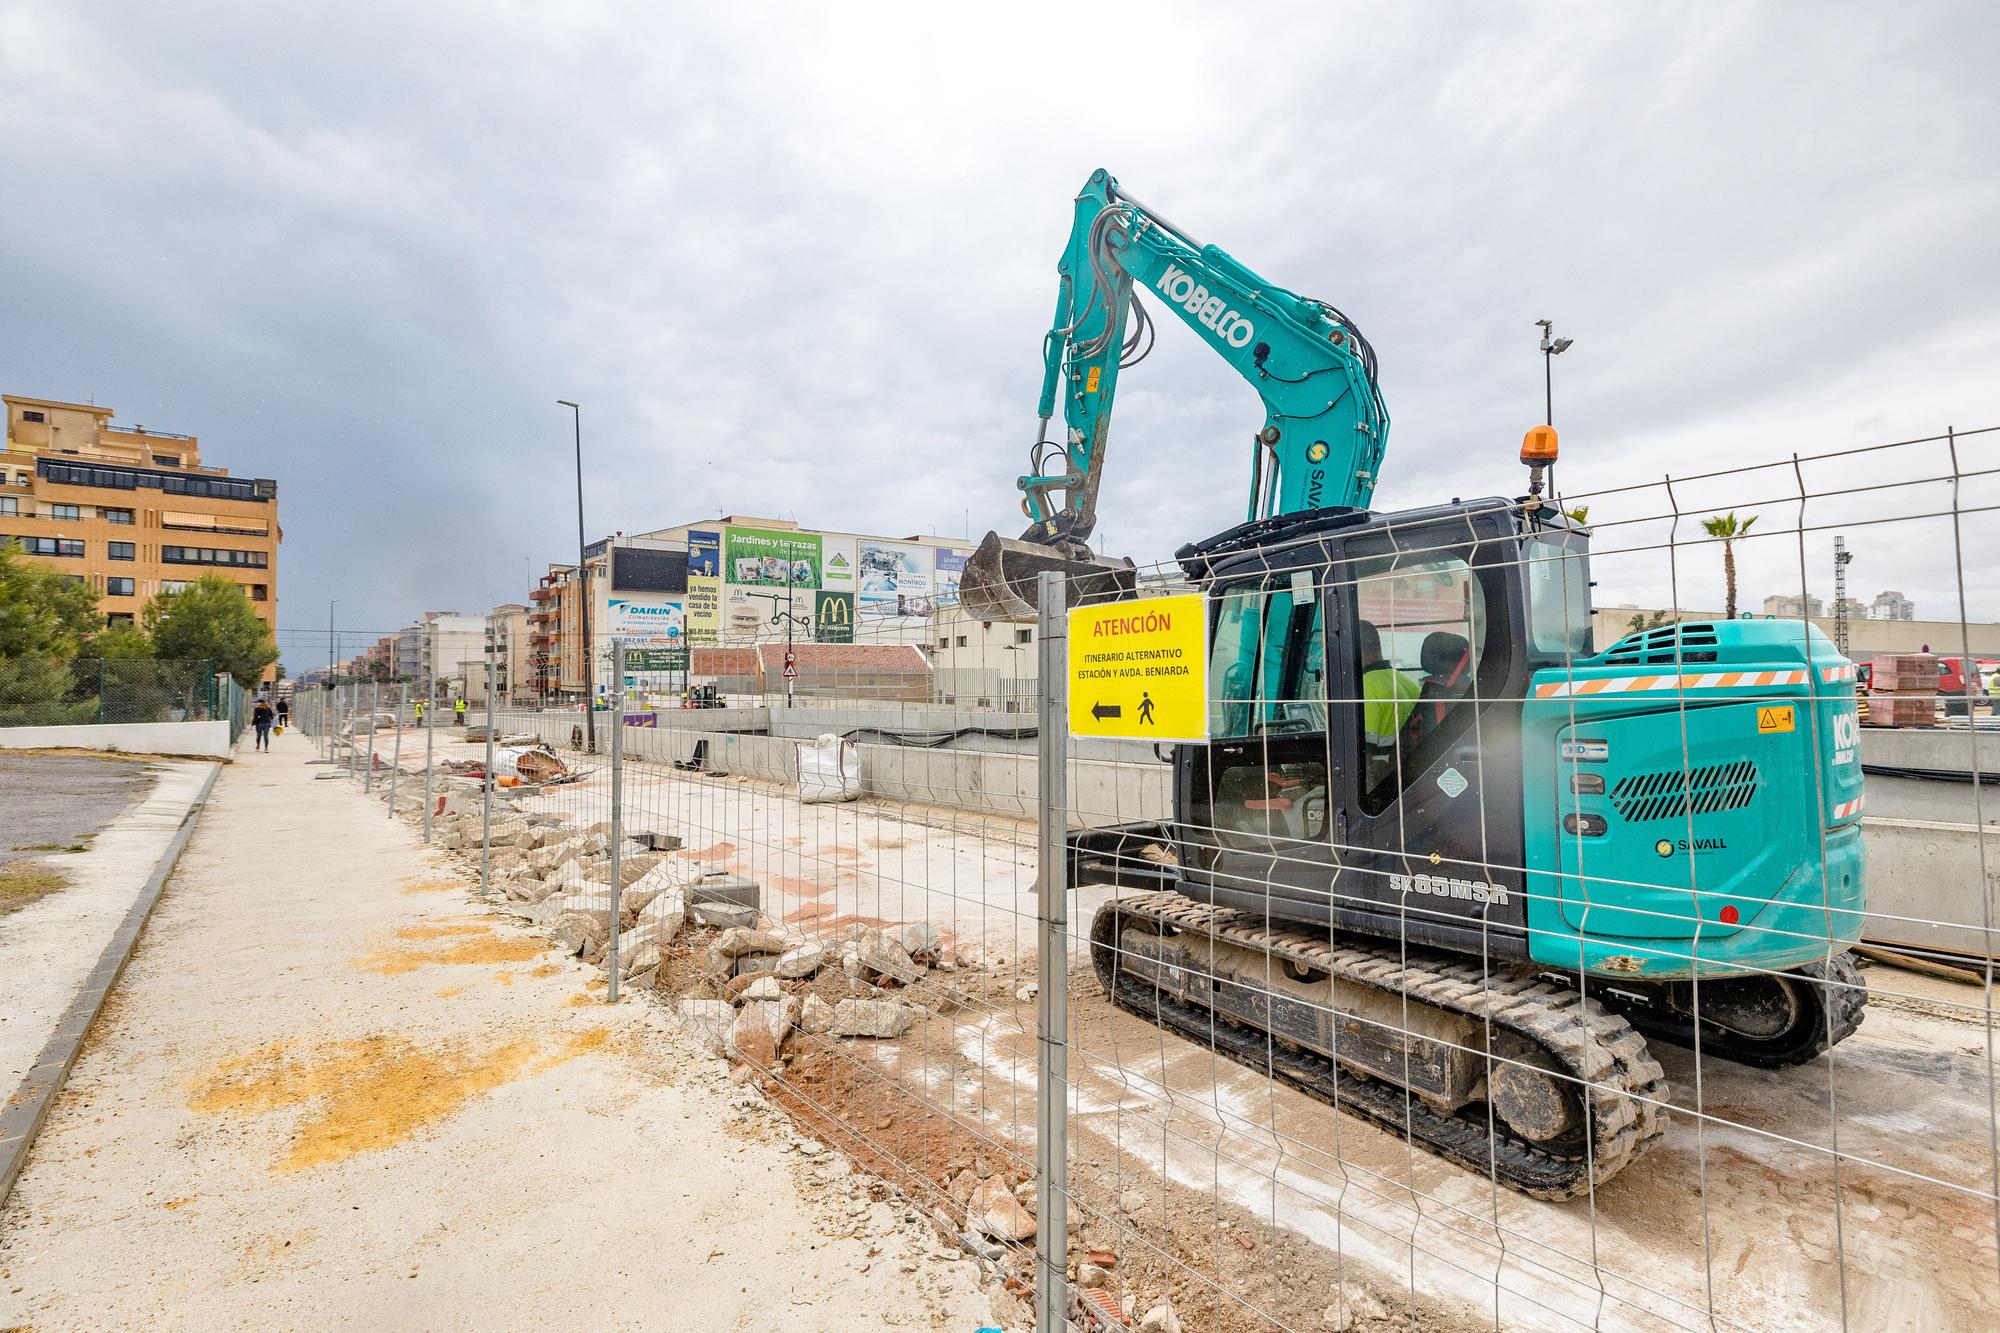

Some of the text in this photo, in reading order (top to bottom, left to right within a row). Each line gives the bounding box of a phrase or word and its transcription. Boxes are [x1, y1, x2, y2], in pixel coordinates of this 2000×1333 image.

[1156, 263, 1254, 348] KOBELCO
[731, 534, 816, 549] Jardines y terrazas
[698, 585, 716, 593] hemos
[630, 607, 671, 615] DAIKIN
[1093, 610, 1171, 637] ATENCIÓN
[1084, 648, 1183, 664] ITINERARIO ALTERNATIVO
[1078, 666, 1189, 679] ESTACIÓN Y AVDA. BENIARDA
[1678, 838, 1727, 850] SAVALL
[1389, 873, 1509, 905] SK85MSR
